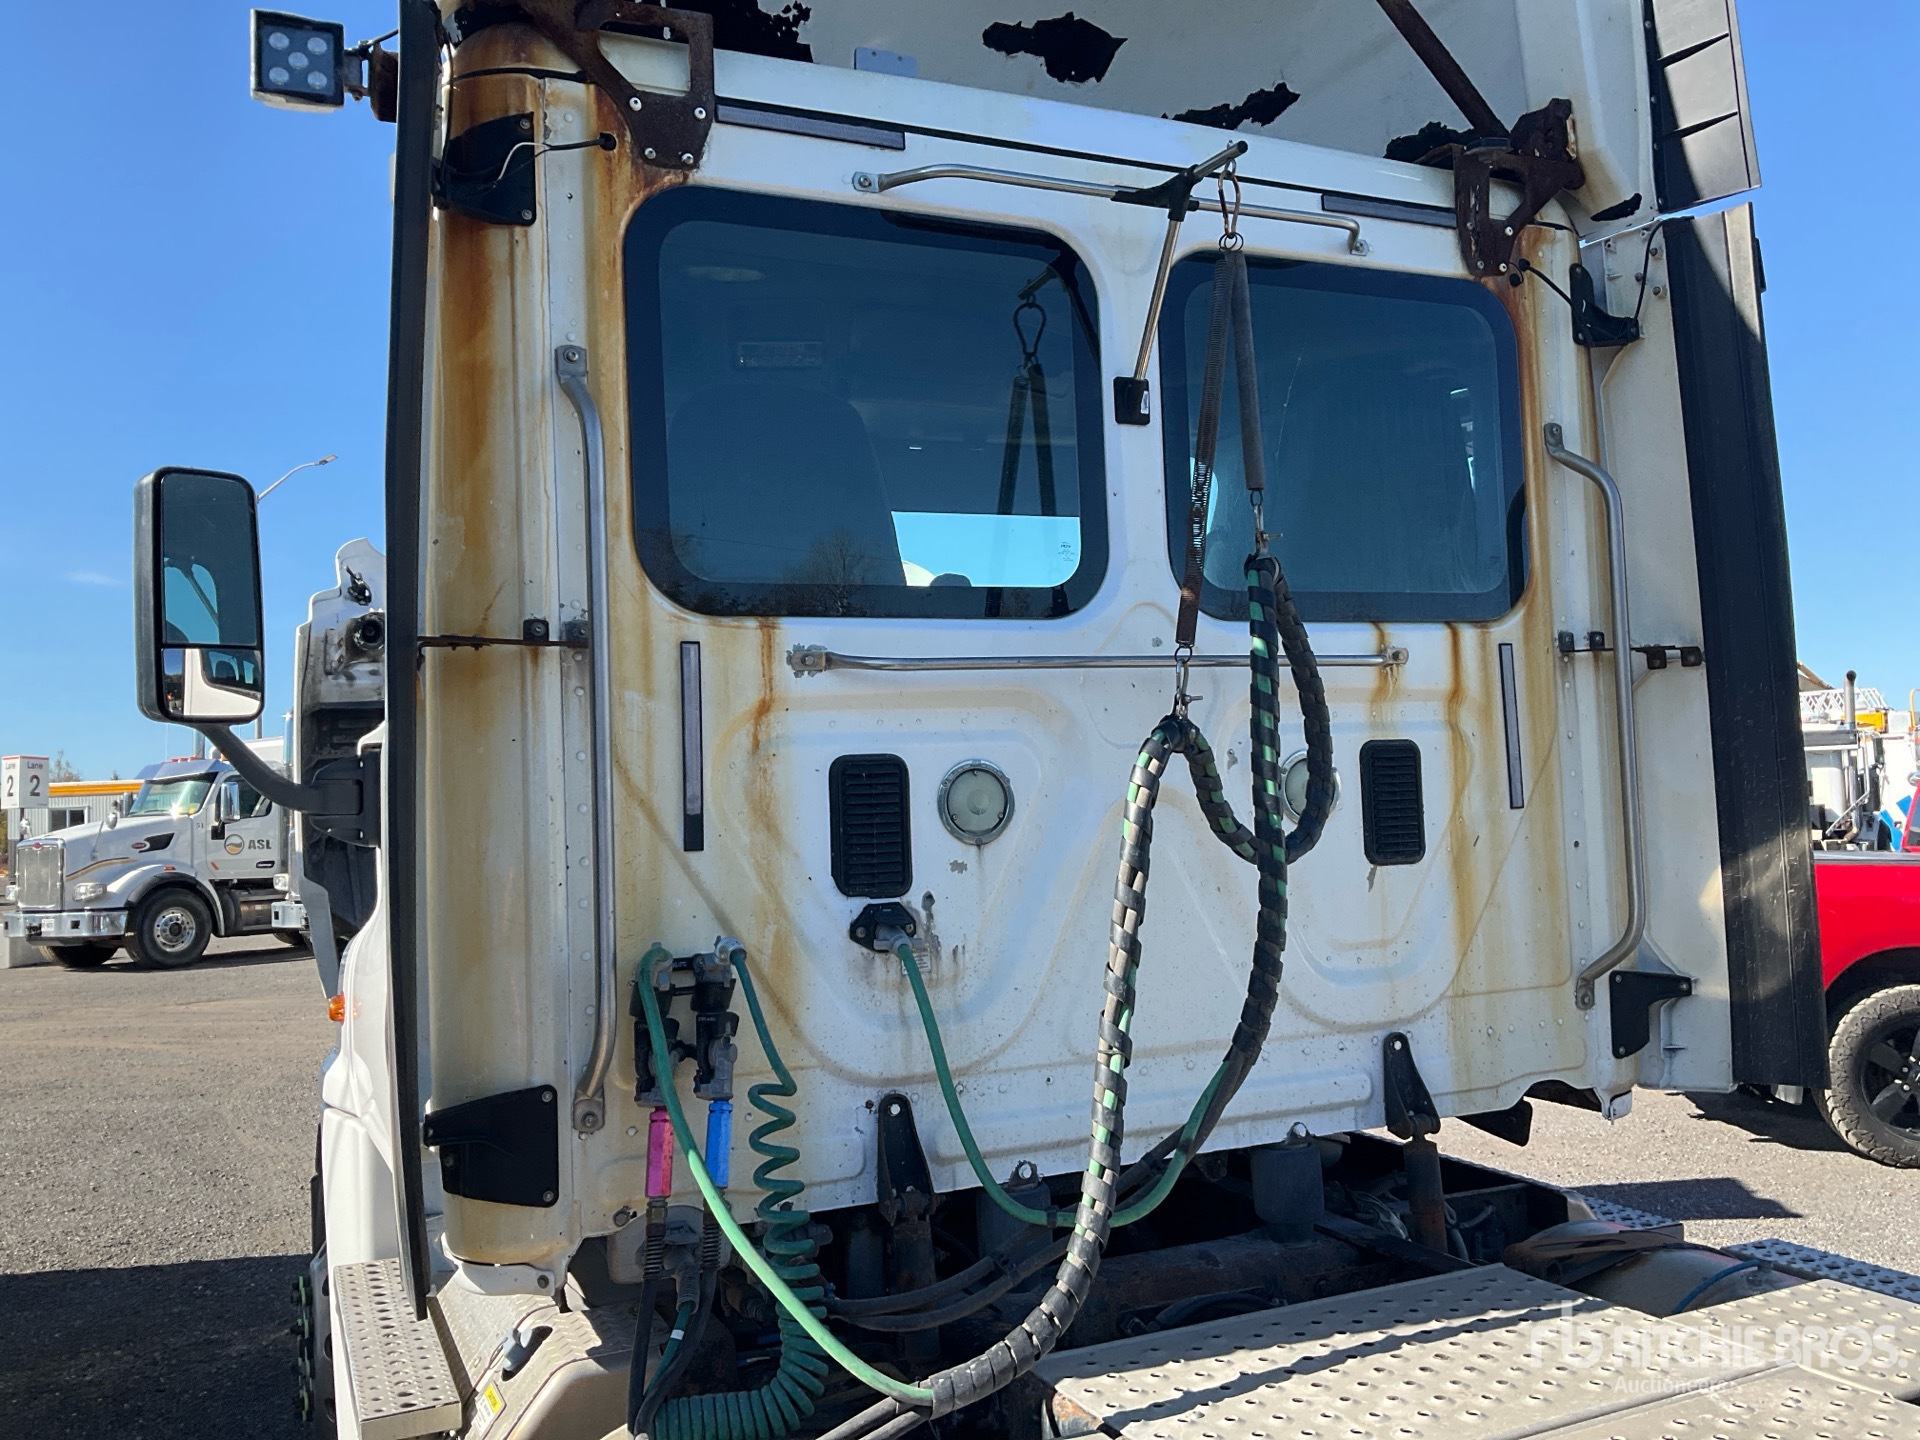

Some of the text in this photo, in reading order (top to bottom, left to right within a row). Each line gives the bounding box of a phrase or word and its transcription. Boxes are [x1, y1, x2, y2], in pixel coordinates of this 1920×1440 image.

[27, 761, 43, 769] Lane
[7, 775, 14, 797] 2
[29, 774, 40, 797] 2
[248, 839, 272, 850] ASL
